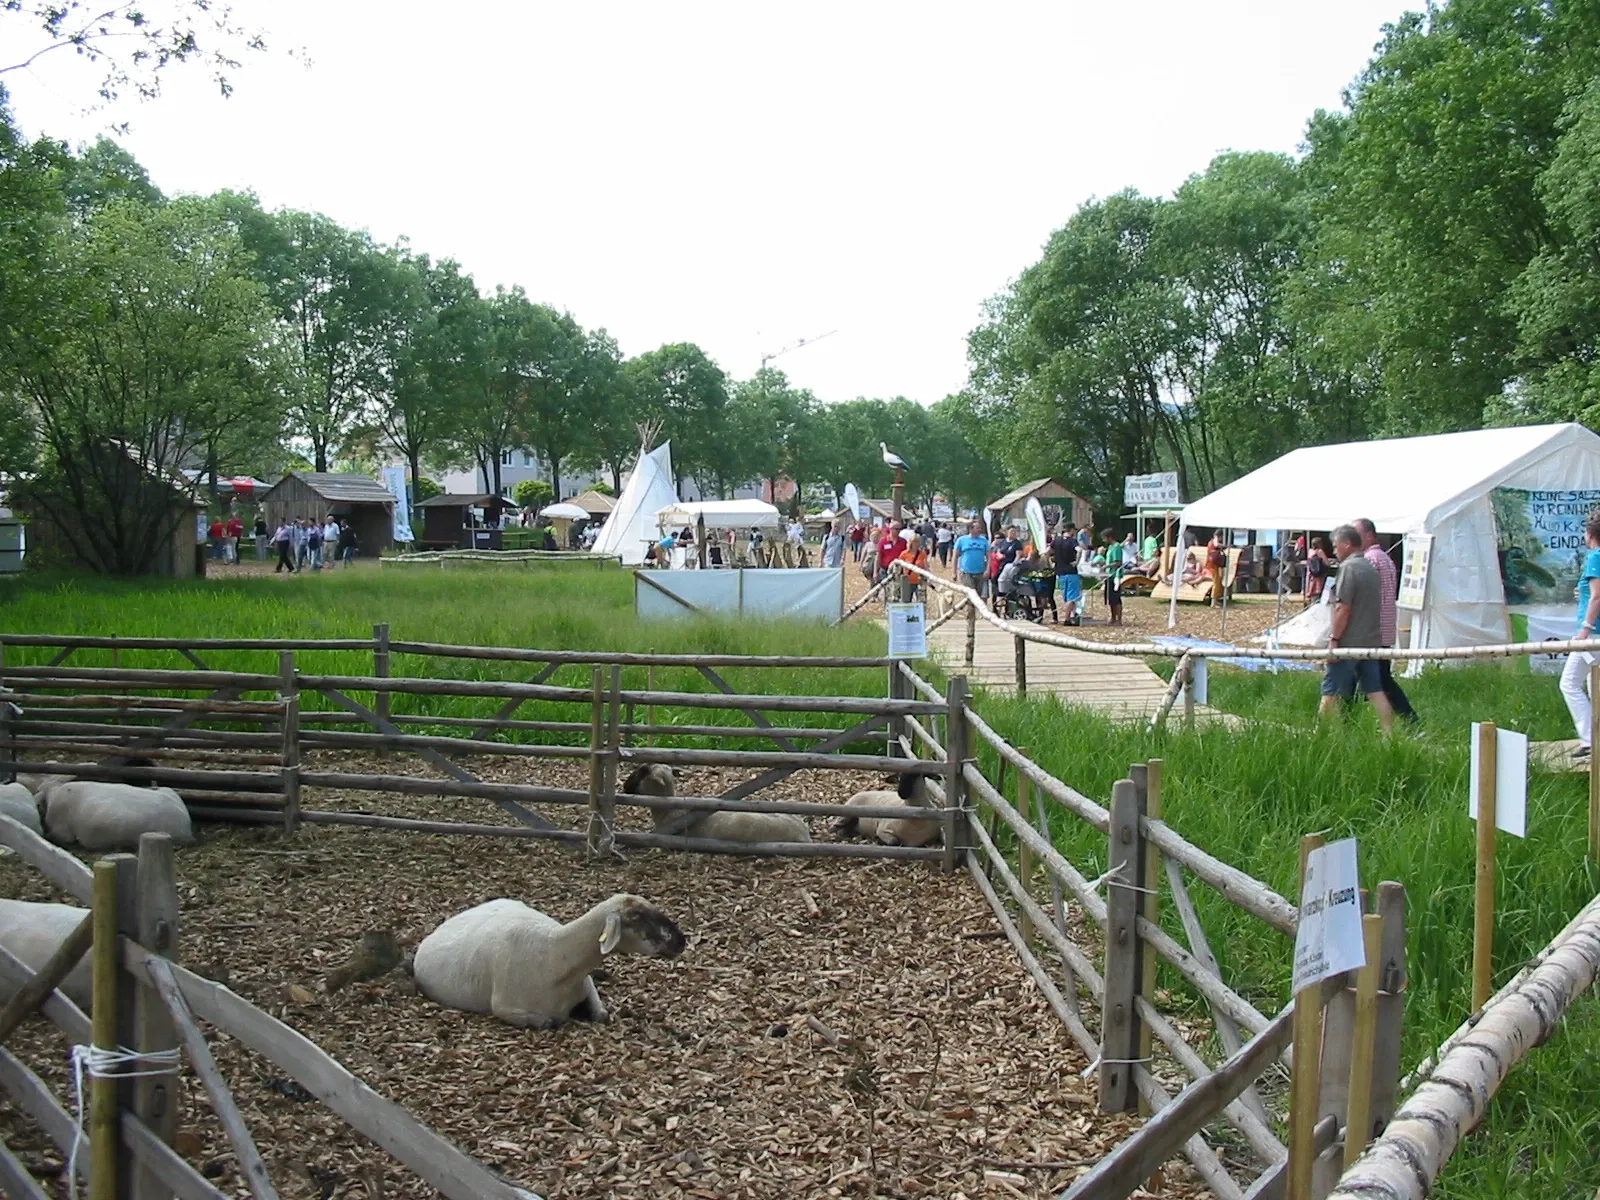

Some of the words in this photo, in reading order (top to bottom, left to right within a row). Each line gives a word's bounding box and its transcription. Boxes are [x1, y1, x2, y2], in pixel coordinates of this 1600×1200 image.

[1533, 491, 1564, 502] KEINE
[1568, 490, 1600, 501] SALZ
[1533, 503, 1545, 514] IM
[1547, 502, 1599, 516] REINHAR
